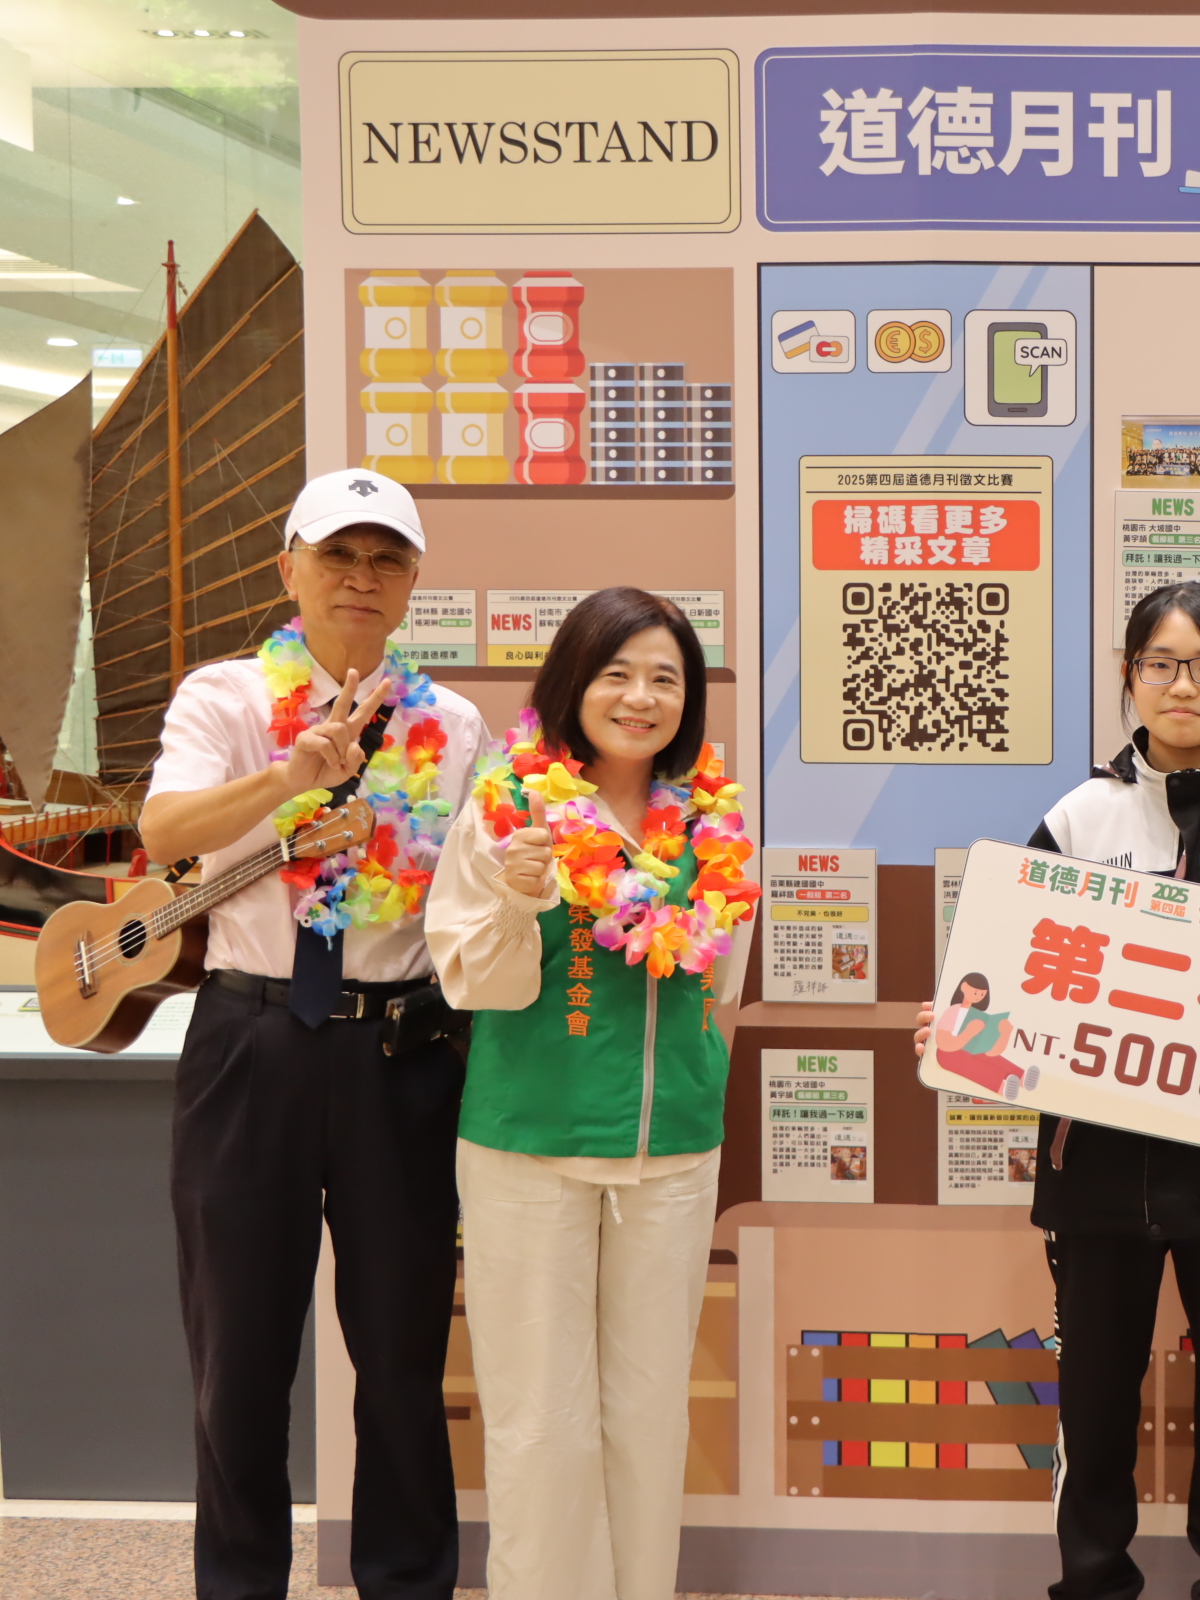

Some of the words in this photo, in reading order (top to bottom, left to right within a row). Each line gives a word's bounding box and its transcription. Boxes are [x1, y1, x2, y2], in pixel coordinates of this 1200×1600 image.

[819, 86, 1172, 178] 道德月刊
[362, 120, 719, 166] NEWSSTAND
[1020, 346, 1062, 358] SCAN
[837, 473, 1014, 487] 2025第四屆道德月刊徵文比賽
[1152, 498, 1194, 516] NEWS
[843, 505, 1008, 535] 掃碼看更多
[860, 536, 991, 566] 精采文章
[491, 613, 532, 631] NEWS
[798, 855, 840, 872] NEWS
[1017, 857, 1139, 909] 道德月刊
[1152, 882, 1189, 905] 2025
[1149, 899, 1186, 918] 第四屆
[797, 1055, 838, 1073] NEWS
